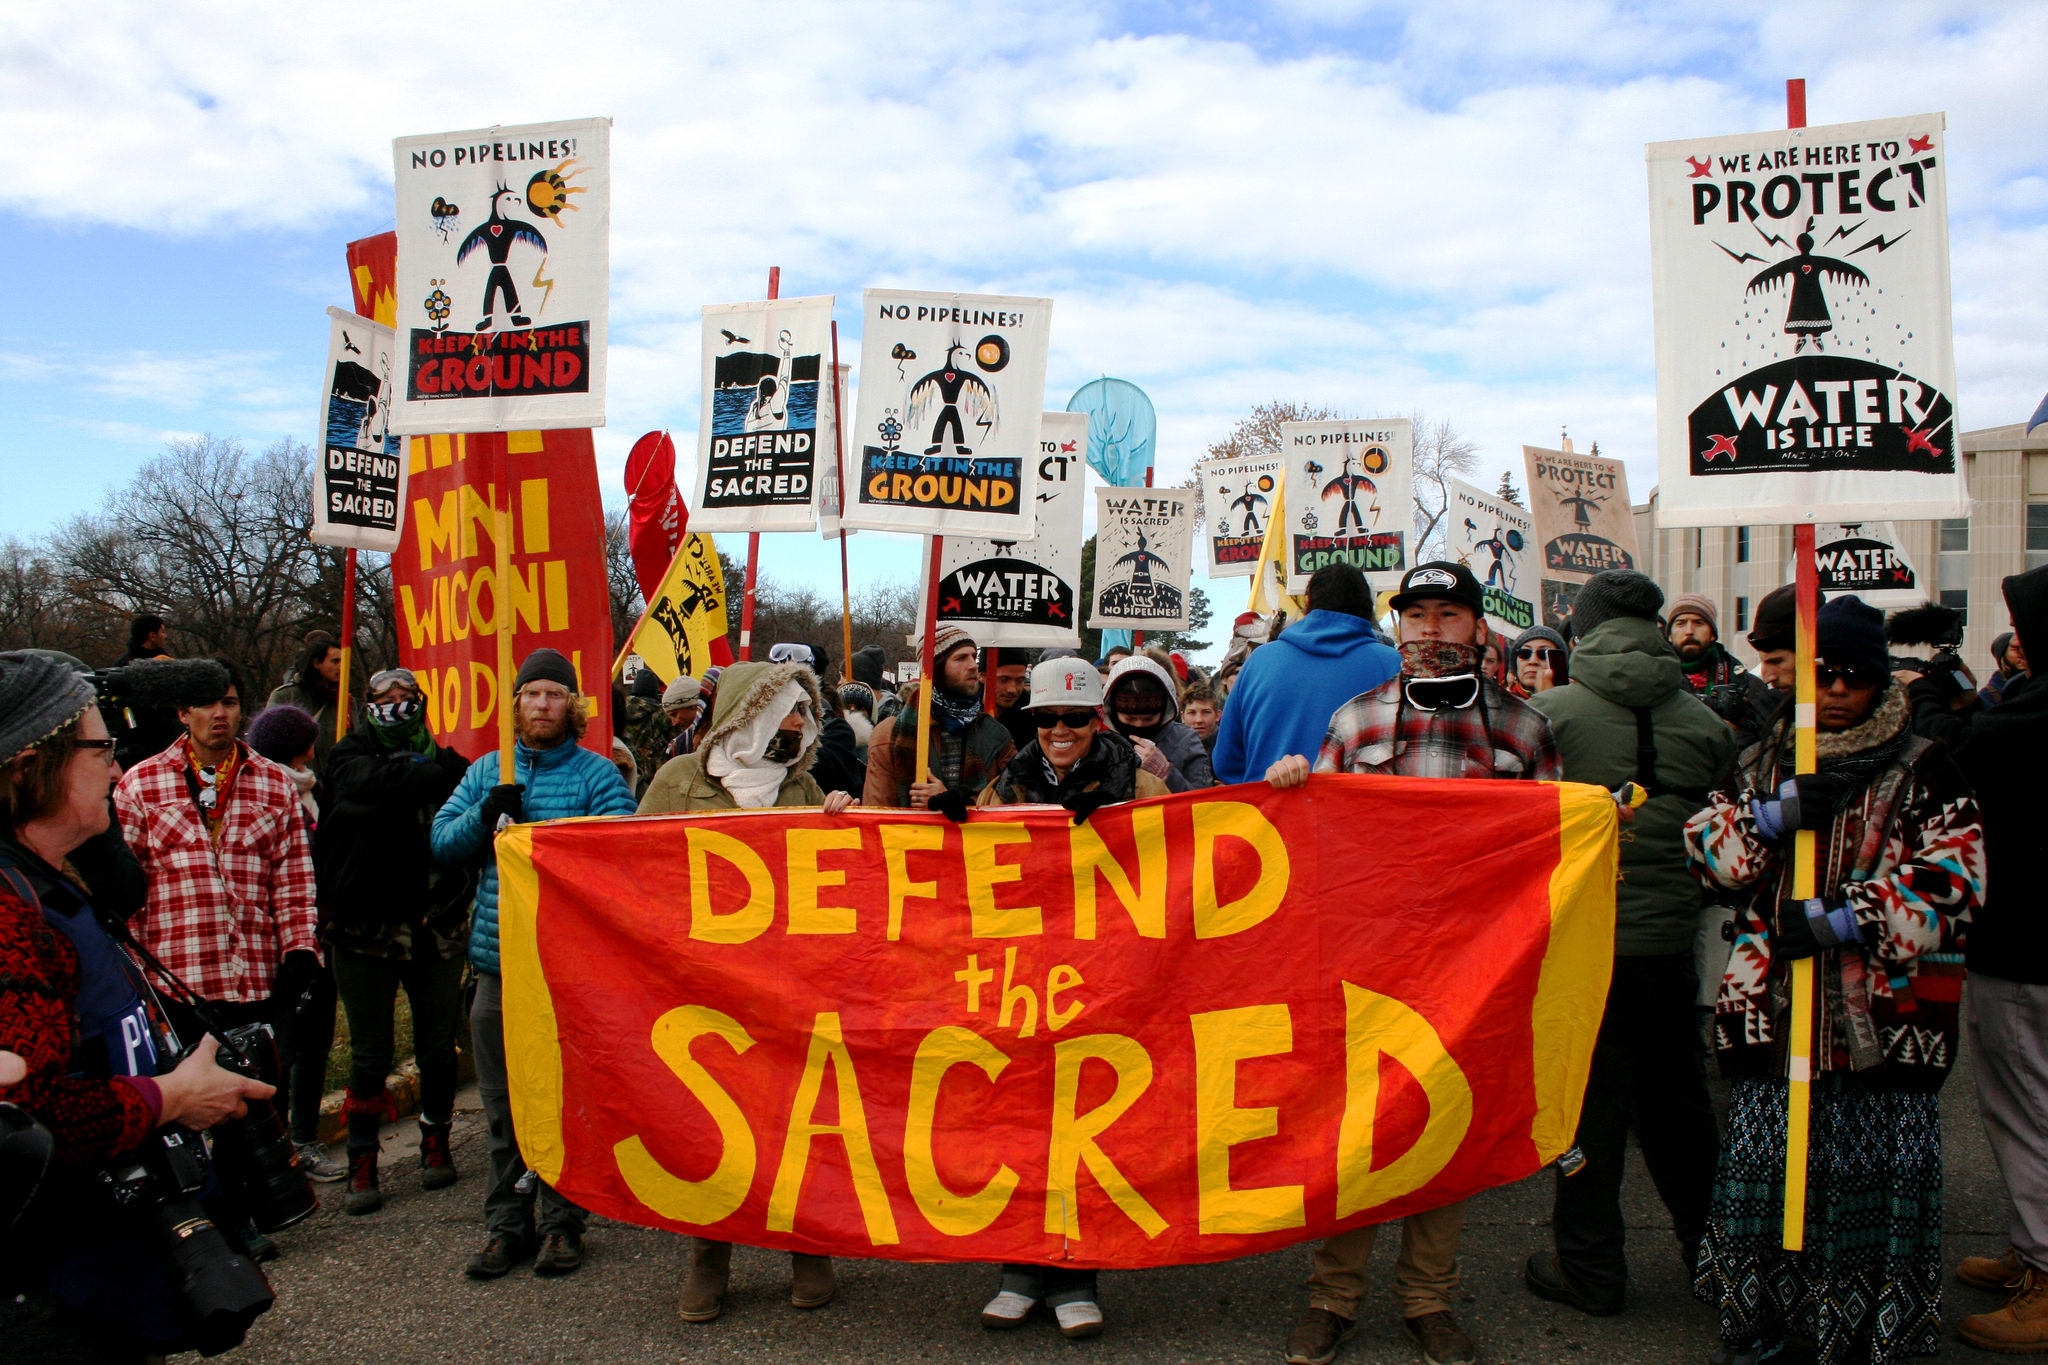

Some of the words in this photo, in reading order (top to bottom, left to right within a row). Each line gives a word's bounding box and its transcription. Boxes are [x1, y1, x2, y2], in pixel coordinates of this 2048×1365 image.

[412, 149, 446, 169] NO
[454, 139, 577, 166] PIPELINES!
[1719, 154, 1750, 174] WE
[1757, 147, 1799, 172] ARE
[1805, 143, 1861, 166] HERE
[1867, 141, 1900, 162] TO
[1692, 156, 1936, 226] PROTECT
[879, 304, 911, 321] NO
[917, 306, 1024, 328] PIPELINES!
[418, 335, 471, 355] KEEP
[475, 333, 494, 350] IT
[501, 332, 529, 349] IN
[532, 328, 581, 347] THE
[416, 350, 582, 394] GROUND
[1723, 378, 1928, 432] WATER
[714, 433, 811, 458] DEFEND
[1040, 441, 1057, 453] TO
[1294, 435, 1316, 446] NO
[1320, 431, 1395, 445] PIPELINES!
[1767, 428, 1796, 450] IS
[1806, 426, 1874, 448] LIFE
[329, 449, 397, 480] DEFEND
[744, 458, 773, 472] THE
[870, 455, 920, 470] KEEP
[924, 457, 943, 472] IT
[948, 458, 970, 474] IN
[973, 461, 1014, 477] THE
[1211, 468, 1226, 477] NO
[1228, 462, 1279, 475] PIPELINES!
[1544, 455, 1557, 464] WE
[1558, 457, 1572, 467] ARE
[1574, 460, 1592, 470] HERE
[1593, 463, 1605, 471] TO
[357, 477, 372, 492] THE
[709, 474, 808, 498] SACRED
[1536, 463, 1616, 490] PROTECT
[868, 472, 1015, 507] GROUND
[331, 492, 395, 519] SACRED
[1106, 498, 1184, 517] WATER
[1458, 492, 1475, 506] NO
[1478, 500, 1531, 530] PIPELINES!
[414, 478, 550, 571] MNI
[1120, 517, 1129, 525] IS
[1131, 517, 1170, 526] SACRED
[1217, 538, 1240, 547] KEEP
[1243, 537, 1251, 545] IT
[1218, 544, 1263, 562] GROU
[1300, 537, 1333, 549] KEEP
[1335, 537, 1348, 547] IT
[1353, 537, 1368, 546] IN
[1372, 535, 1400, 546] THE
[1556, 538, 1627, 563] WATER
[1299, 548, 1400, 572] GROUND
[1572, 556, 1584, 566] IS
[1585, 559, 1610, 569] LIFE
[1815, 548, 1902, 572] WATER
[956, 570, 1060, 602] WATER
[1832, 571, 1846, 581] IS
[1850, 570, 1880, 581] LIFE
[400, 559, 570, 649] WICONI
[977, 597, 992, 610] IS
[997, 598, 1033, 612] LIFE
[1104, 606, 1121, 616] NO
[1123, 607, 1180, 617] PIPELINES!
[1482, 595, 1532, 628] OUND
[1485, 586, 1497, 596] IT
[1511, 599, 1530, 612] THE
[414, 665, 462, 735] NO
[469, 650, 598, 729] DL
[686, 799, 1291, 944] DEFEND
[954, 947, 1085, 1039] the
[612, 978, 1476, 1248] SACRED
